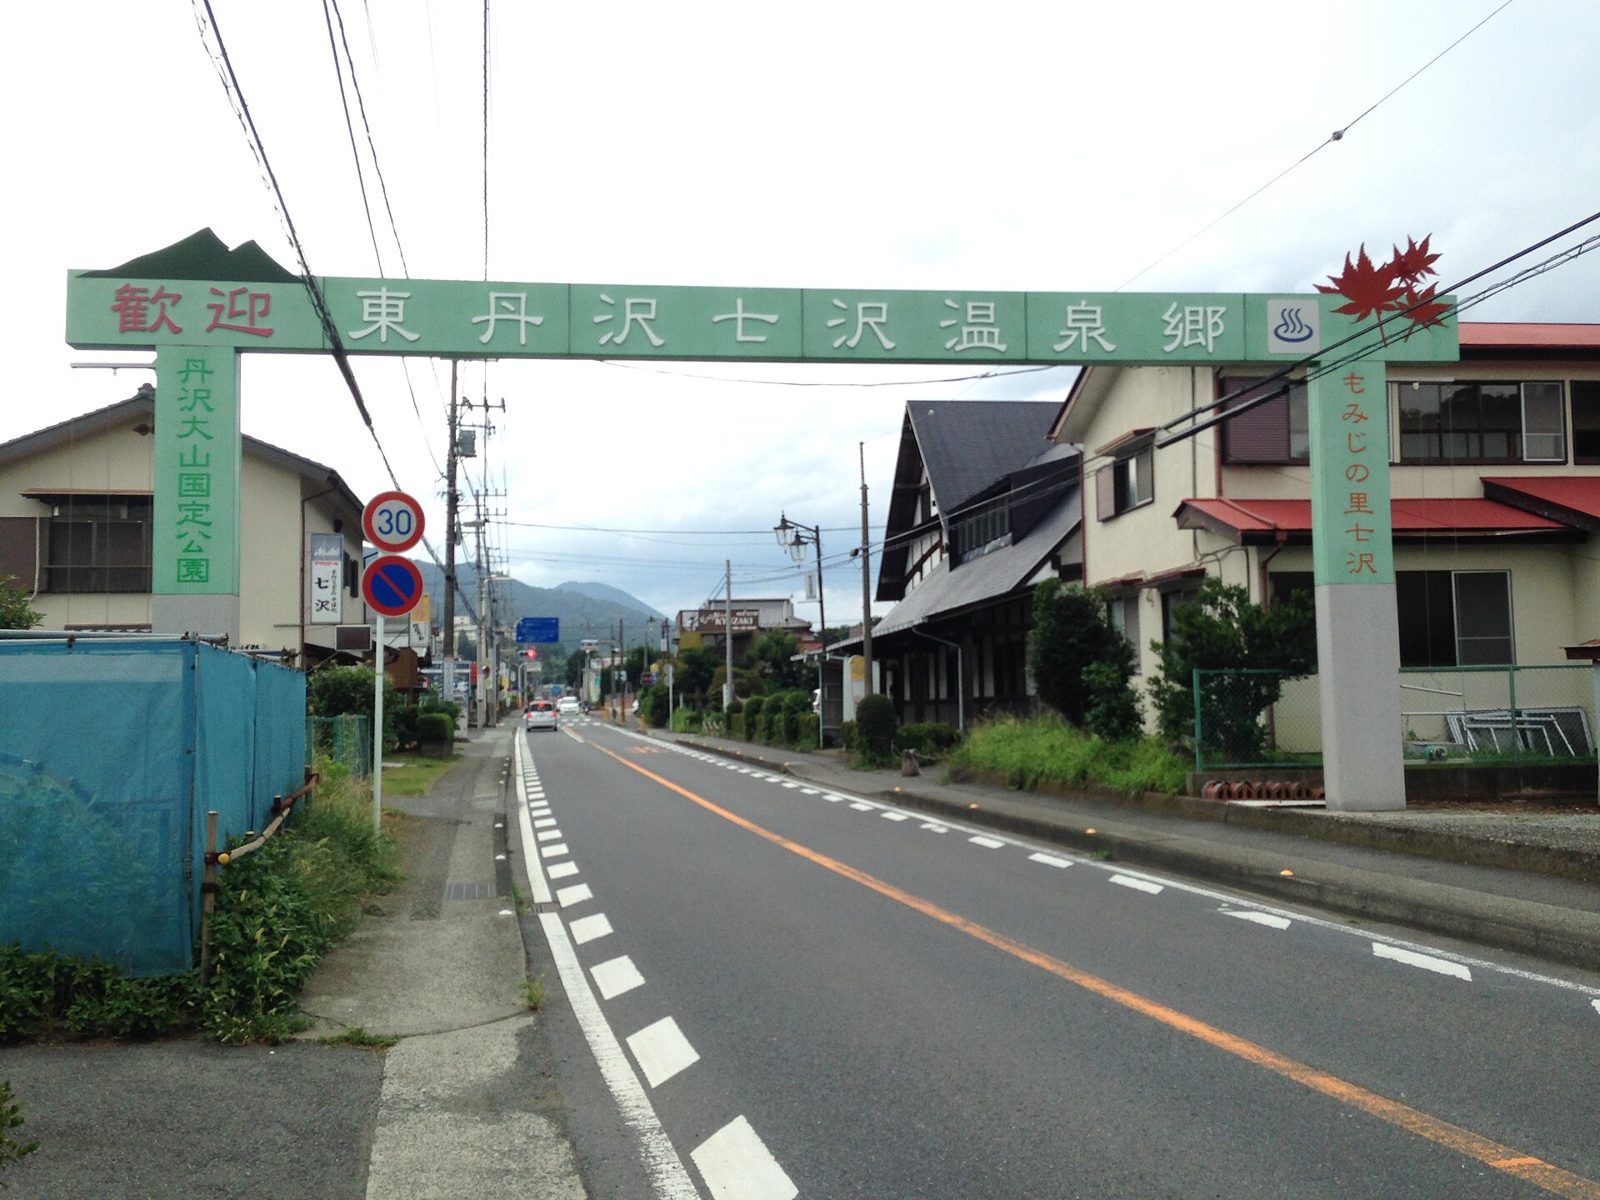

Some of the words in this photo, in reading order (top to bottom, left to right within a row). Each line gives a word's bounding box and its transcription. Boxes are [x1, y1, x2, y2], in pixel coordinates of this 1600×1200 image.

[110, 282, 274, 337] 歓迎
[348, 286, 1227, 353] 東丹沢七沢温泉郷
[176, 358, 215, 583] 丹沢大山国定公園
[1342, 372, 1378, 575] もみじの里七沢
[378, 509, 411, 535] 30
[314, 576, 330, 613] 七沢
